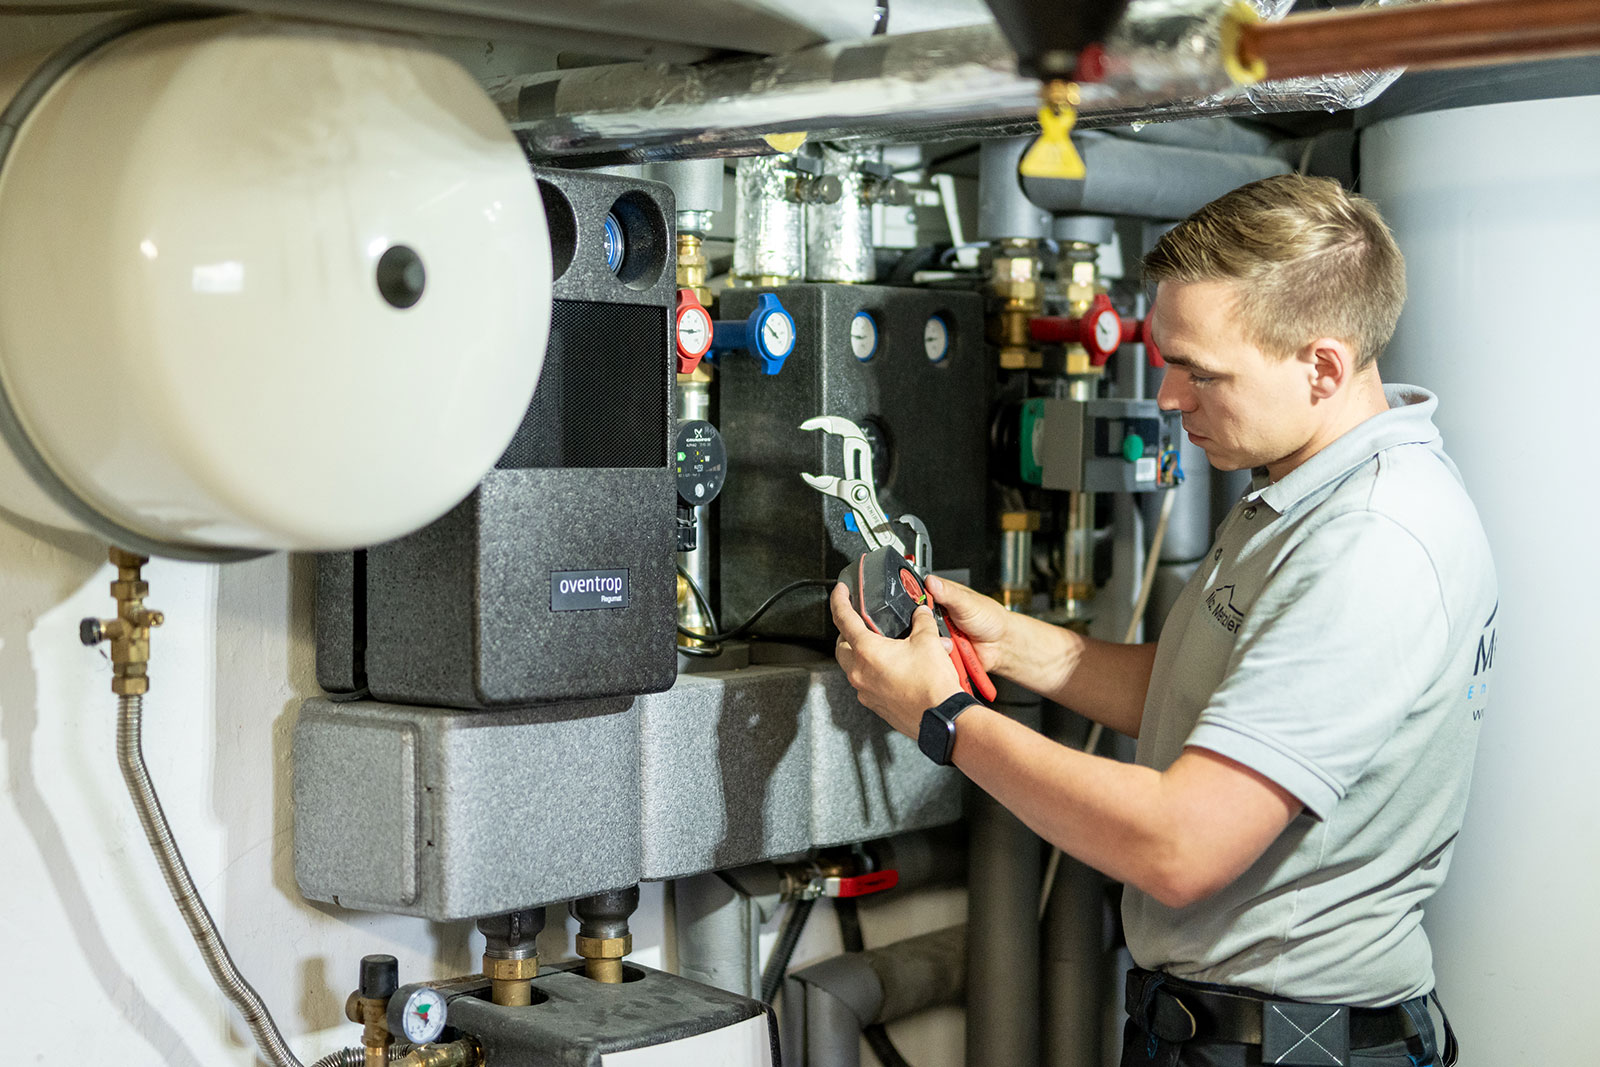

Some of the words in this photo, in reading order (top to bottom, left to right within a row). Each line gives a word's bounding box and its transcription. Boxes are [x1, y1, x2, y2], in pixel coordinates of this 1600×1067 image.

[560, 576, 622, 594] oventrop
[1212, 603, 1241, 634] Metzler
[1473, 628, 1498, 676] M
